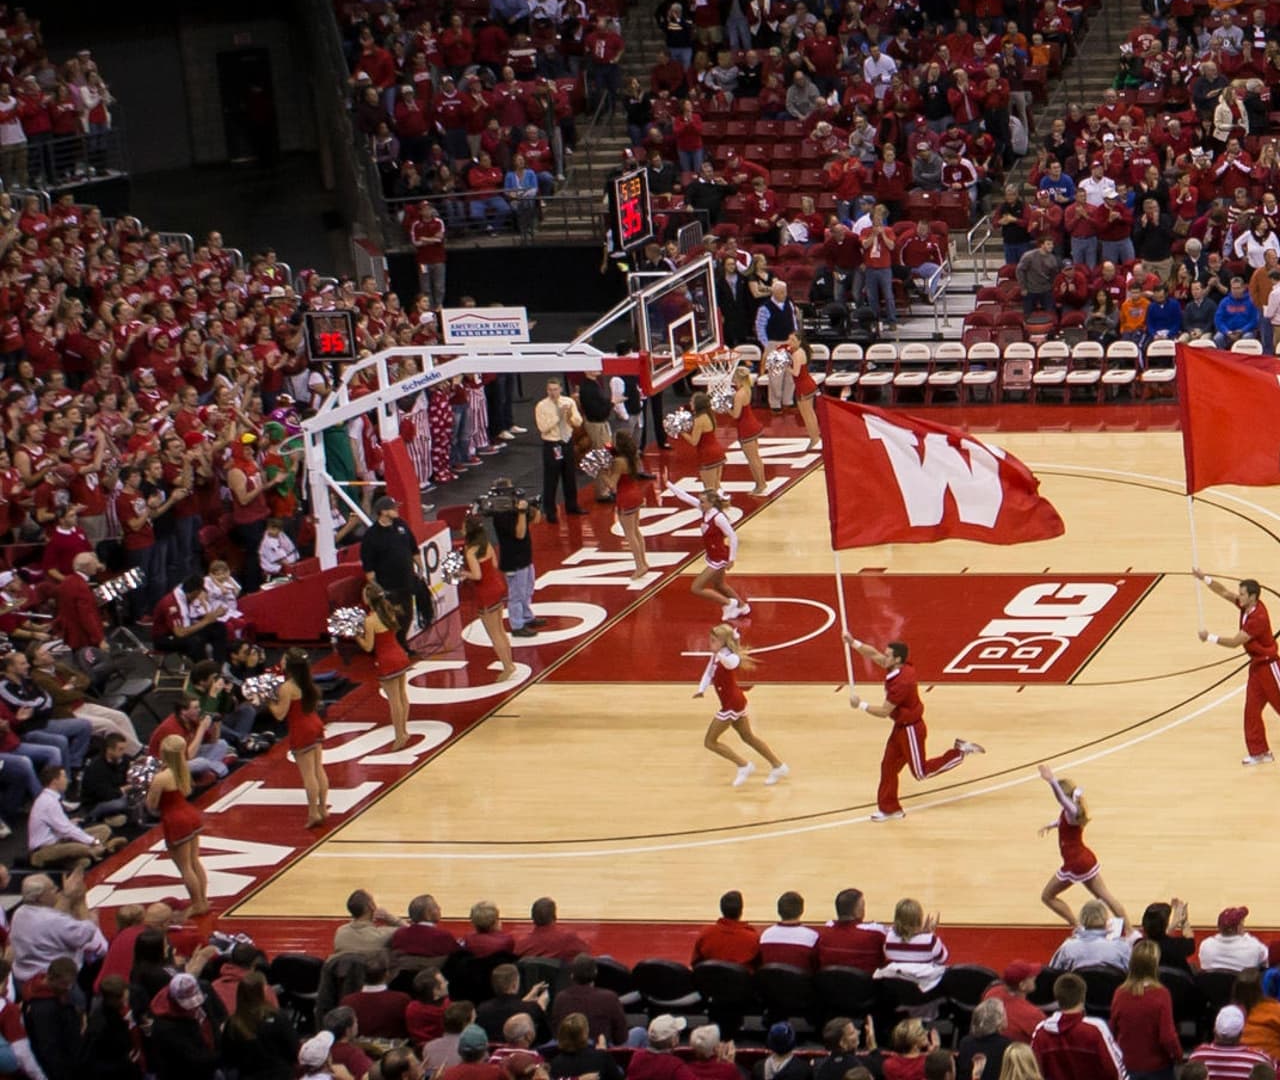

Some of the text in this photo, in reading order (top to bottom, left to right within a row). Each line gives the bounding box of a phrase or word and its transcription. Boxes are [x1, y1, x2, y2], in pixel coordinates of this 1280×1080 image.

[319, 332, 345, 353] 35
[401, 370, 442, 393] Schelde
[862, 414, 1007, 528] W
